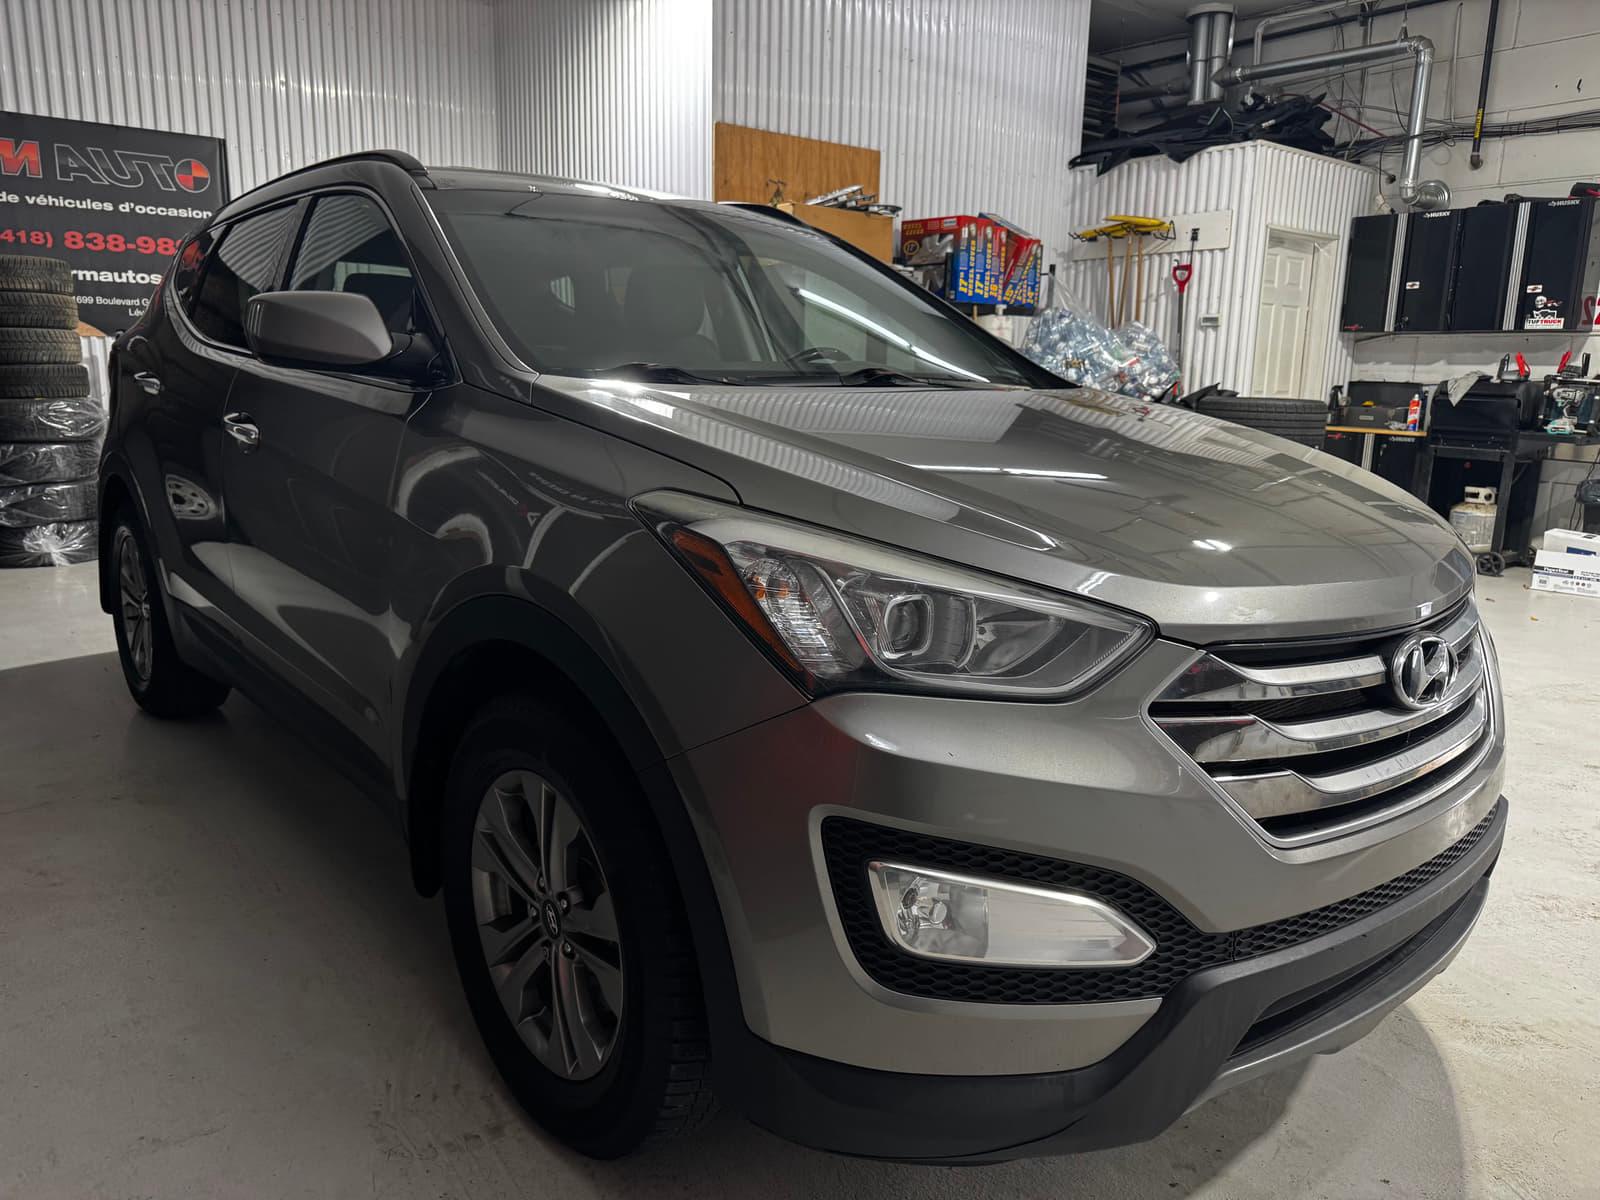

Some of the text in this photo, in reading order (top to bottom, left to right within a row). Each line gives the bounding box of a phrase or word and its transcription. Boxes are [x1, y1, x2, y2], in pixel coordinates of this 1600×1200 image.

[24, 194, 114, 211] véhicules
[118, 201, 212, 219] d'occasion
[63, 230, 182, 256] 838-98
[95, 296, 140, 306] Boulevard
[141, 298, 151, 306] G
